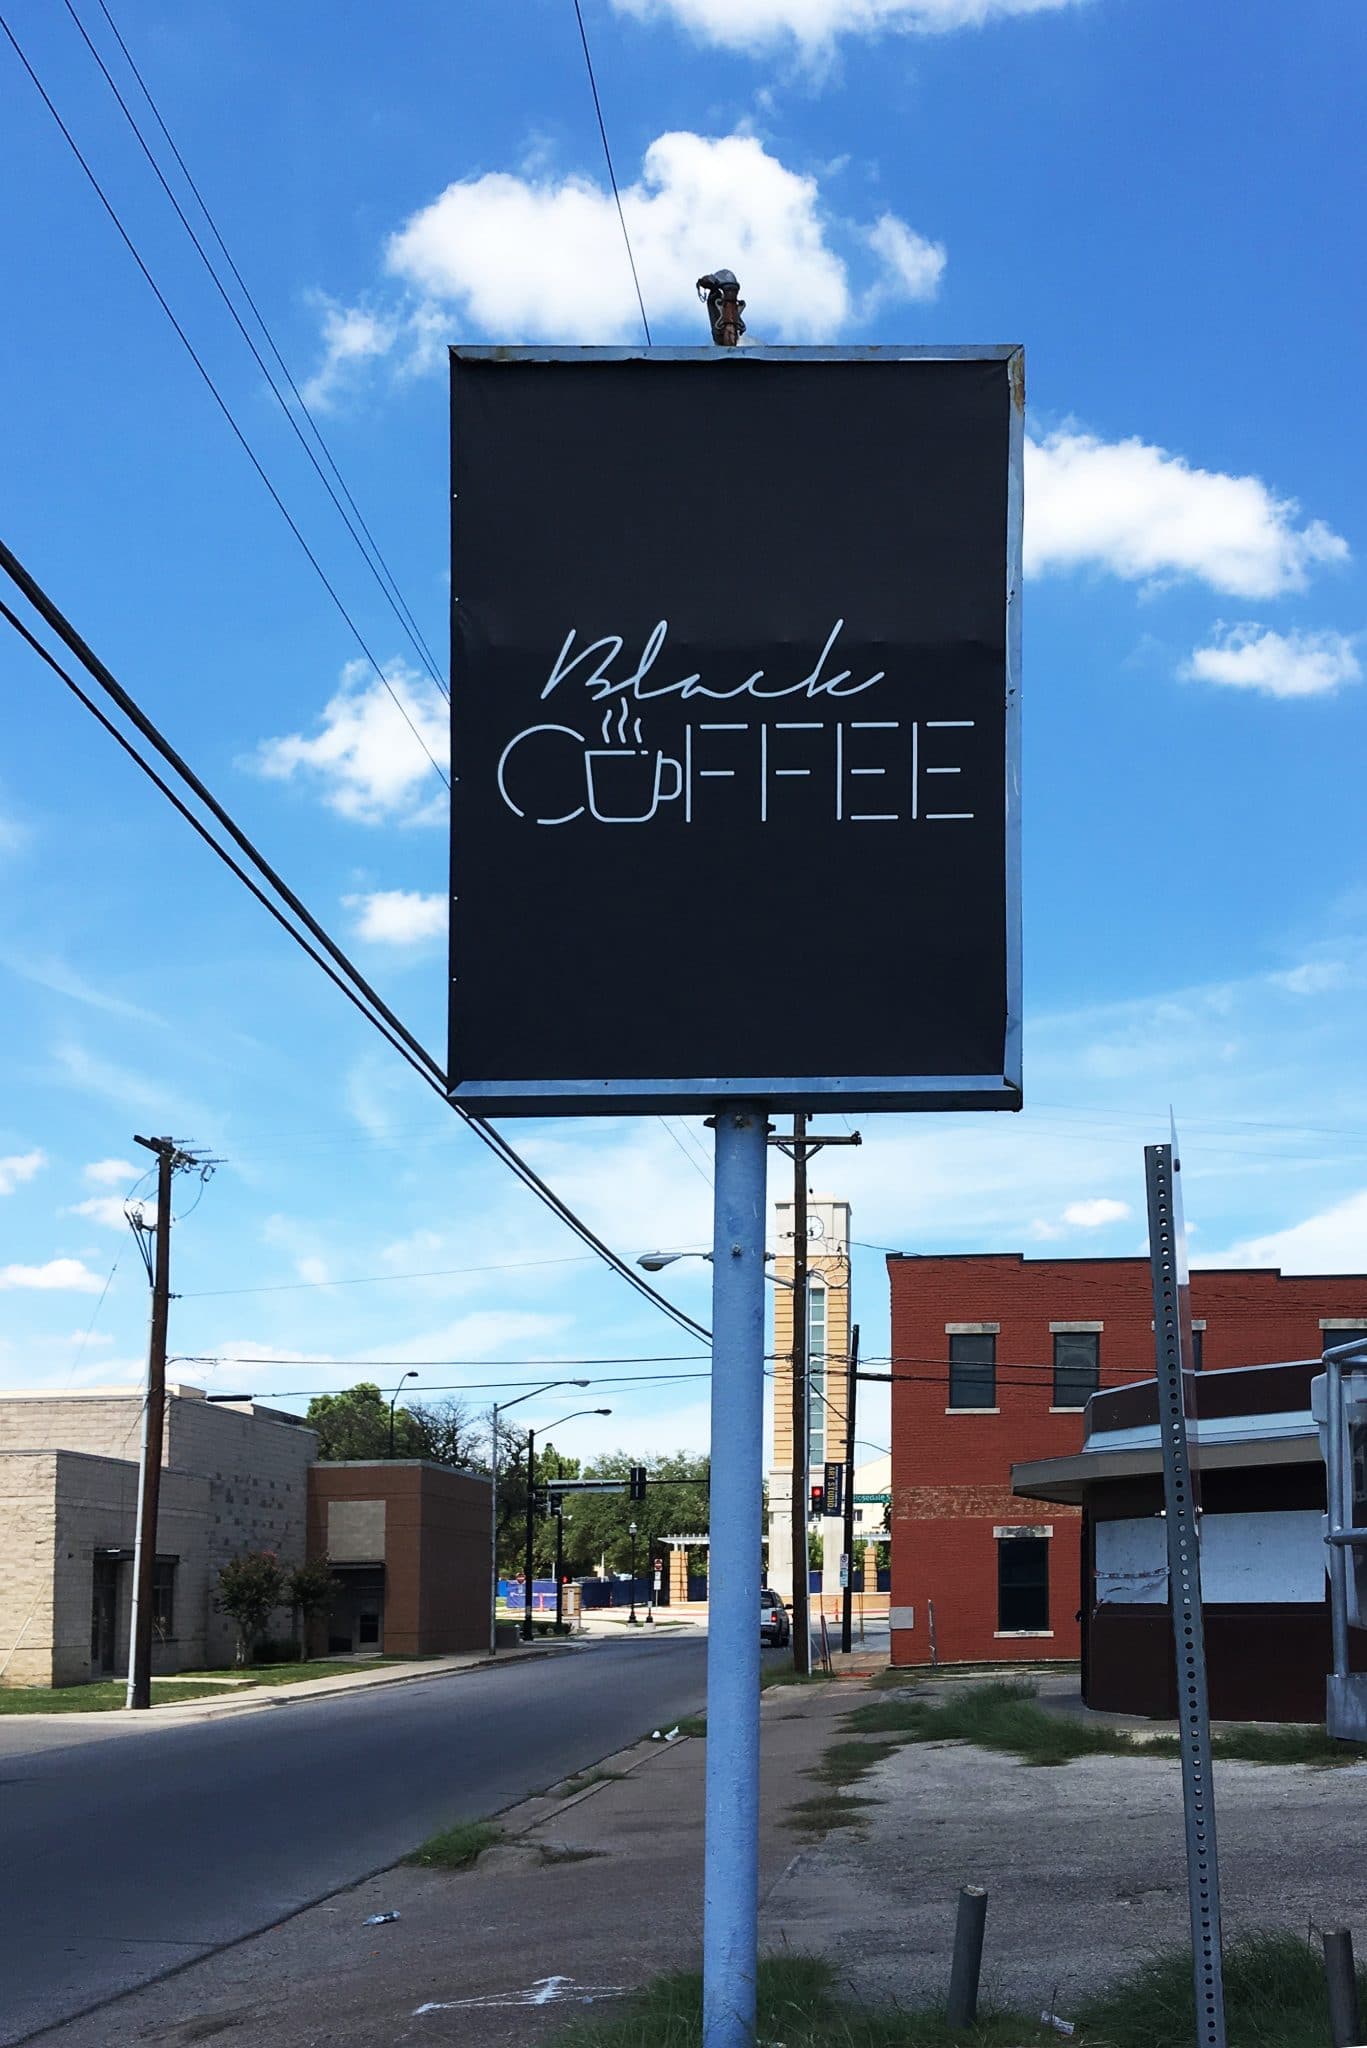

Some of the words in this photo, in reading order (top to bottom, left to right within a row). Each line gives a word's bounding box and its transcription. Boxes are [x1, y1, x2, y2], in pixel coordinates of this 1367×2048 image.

[541, 619, 884, 701] Black
[827, 1466, 835, 1480] ART
[827, 1482, 835, 1508] STUDIO
